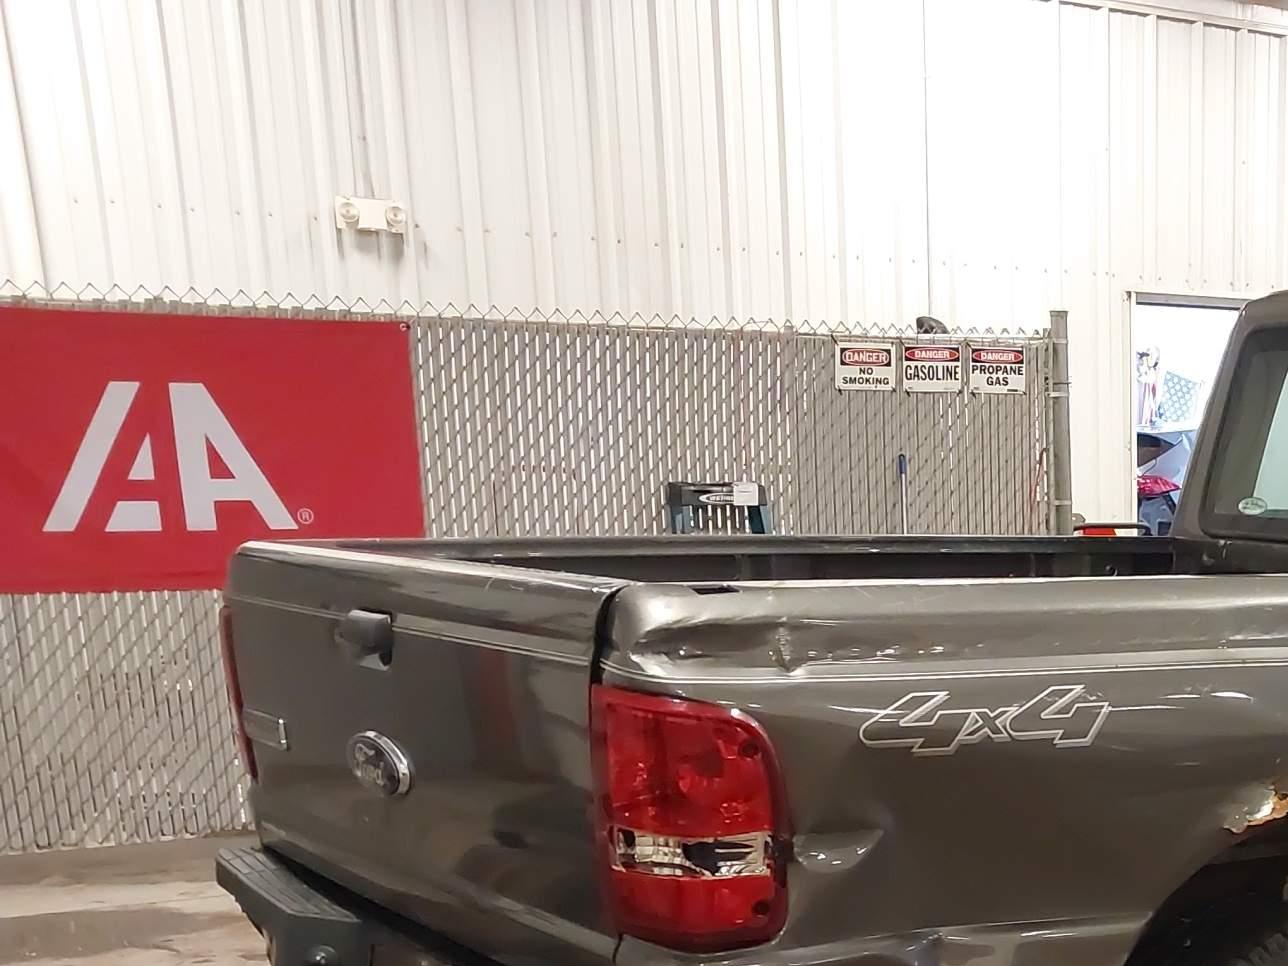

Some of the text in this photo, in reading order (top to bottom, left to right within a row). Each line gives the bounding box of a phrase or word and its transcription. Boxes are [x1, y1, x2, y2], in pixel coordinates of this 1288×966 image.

[845, 350, 888, 363] DANGER
[914, 350, 951, 360] DANGER
[980, 351, 1016, 362] DANGER
[858, 367, 874, 376] NO
[904, 364, 960, 382] GASOLINE
[971, 364, 1024, 376] PROPANE
[841, 376, 890, 386] SMOKING
[986, 376, 1010, 387] GAS
[859, 684, 1112, 757] 4x4
